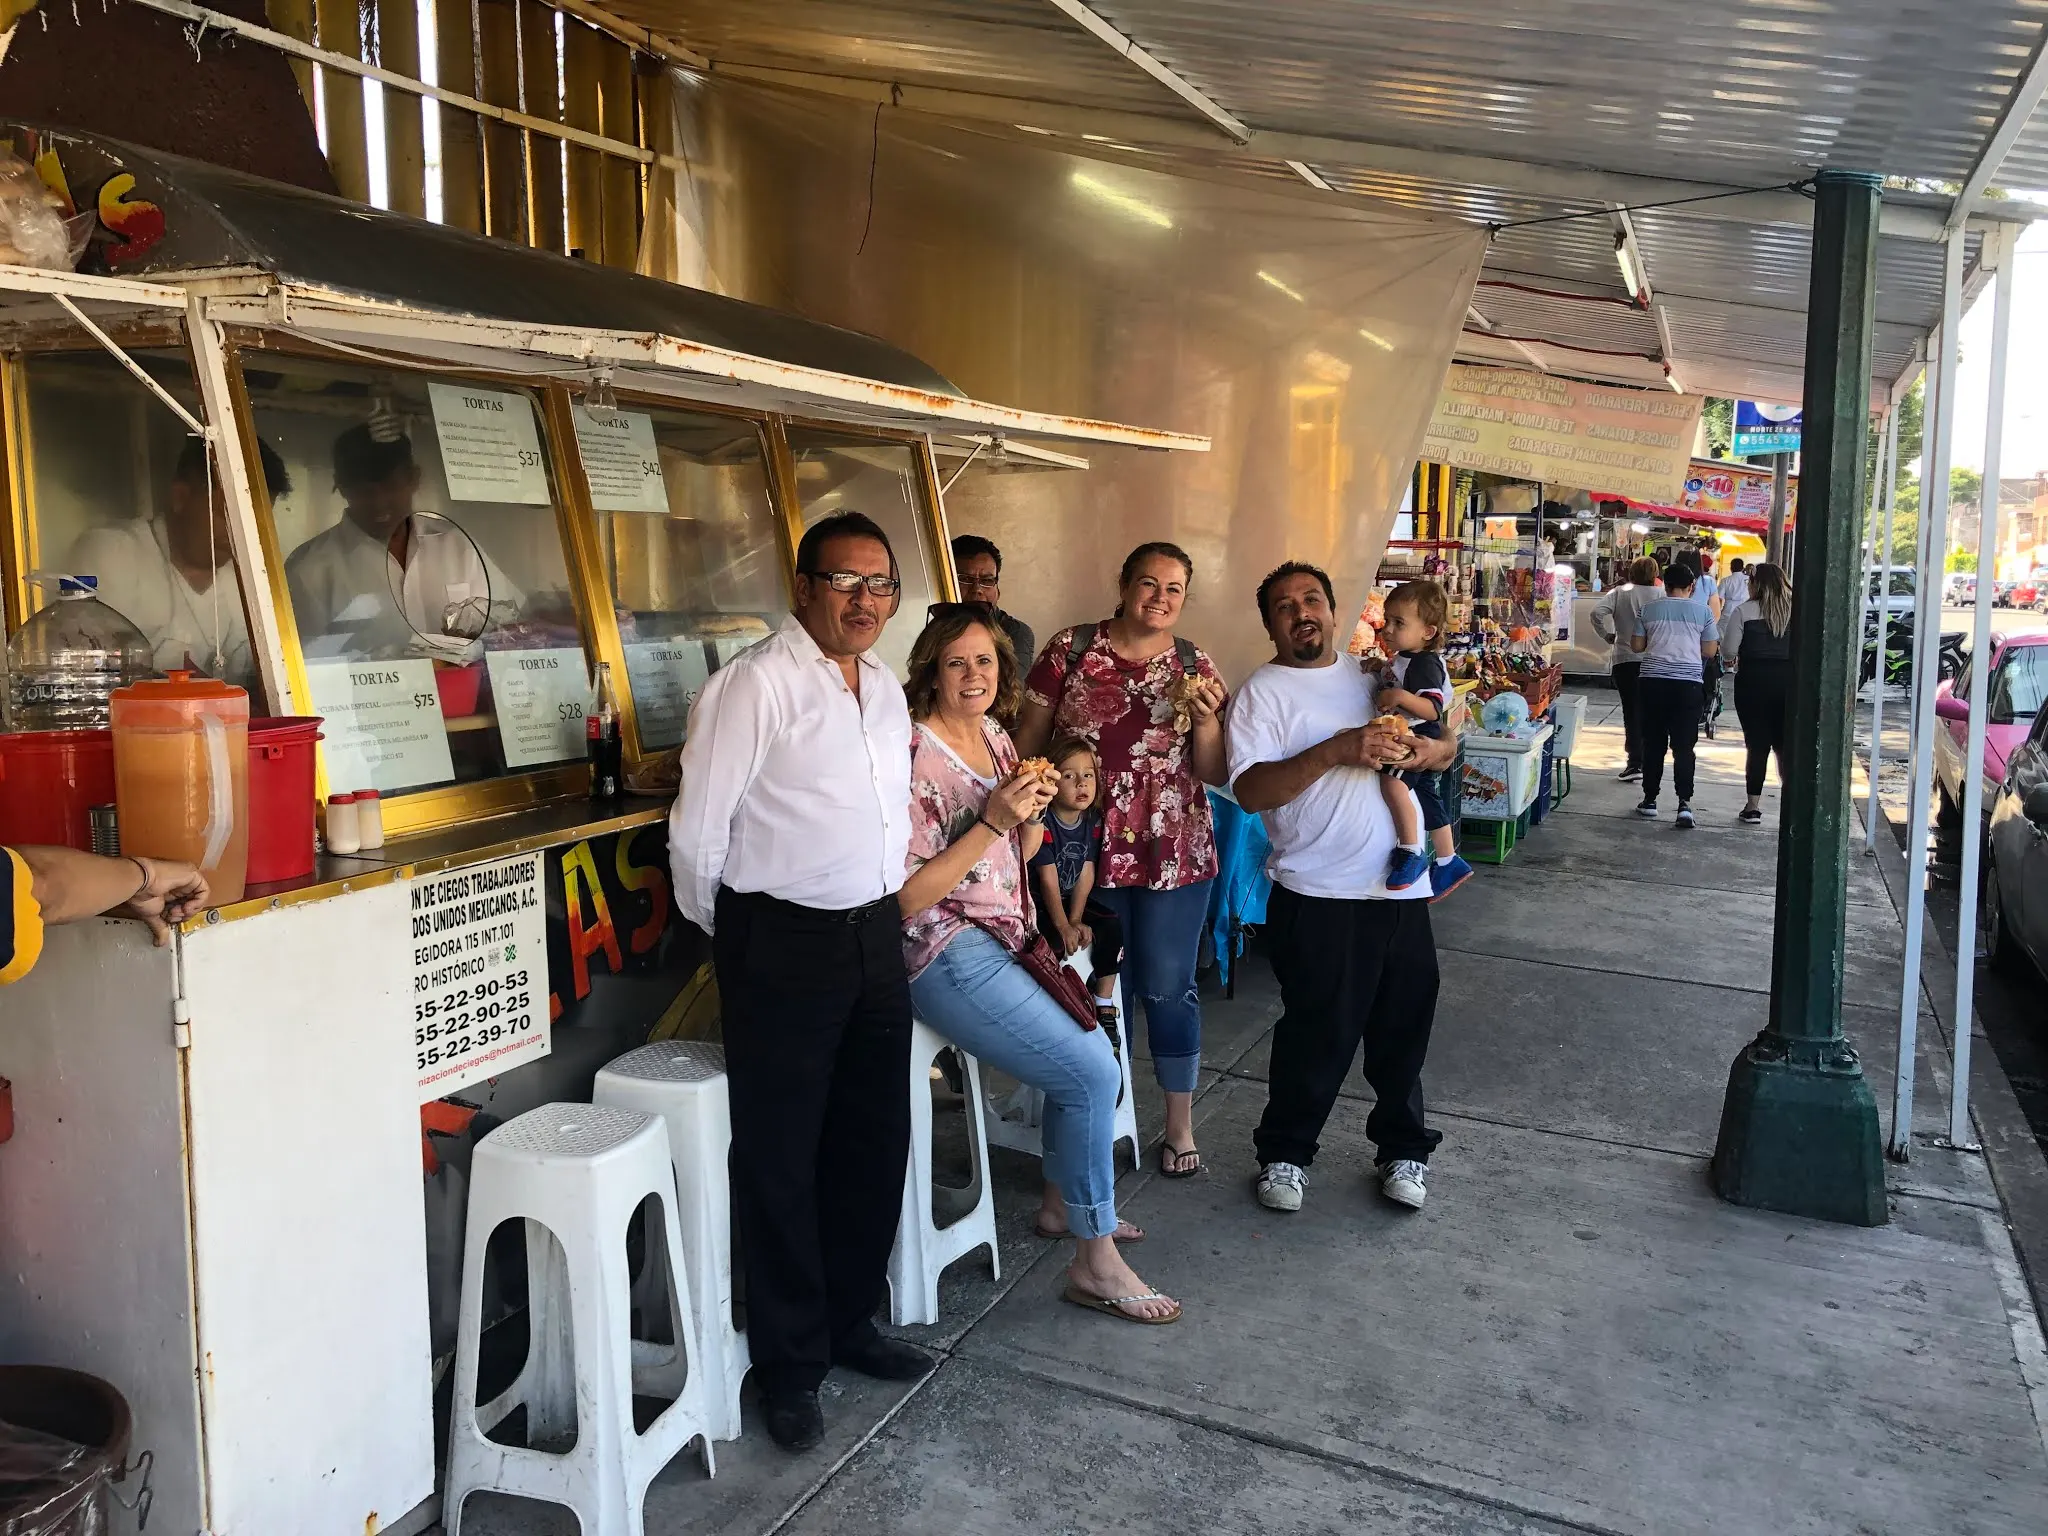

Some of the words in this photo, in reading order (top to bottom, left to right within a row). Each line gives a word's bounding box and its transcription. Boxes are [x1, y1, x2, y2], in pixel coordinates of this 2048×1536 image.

[462, 396, 504, 412] TORTAS
[518, 448, 539, 468] $37
[642, 460, 662, 476] $42
[519, 658, 558, 670] TORTAS
[650, 650, 682, 662] TORTAS
[350, 671, 400, 686] TORTAS
[350, 702, 381, 710] ESPECIAL
[414, 693, 434, 709] $75
[558, 702, 583, 722] $28
[424, 883, 436, 907] DE
[438, 875, 470, 905] CIEGOS
[471, 860, 536, 896] TRABAJADORES
[412, 912, 430, 939] DOS
[433, 904, 466, 933] UNIDOS
[469, 890, 520, 924] MEXICANOS,
[522, 886, 538, 909] A.C.
[415, 936, 462, 966] EGIDORA
[465, 932, 479, 950] 115
[482, 922, 514, 947] INT.101
[432, 956, 485, 989] HISTÓRICO
[418, 1032, 542, 1087] nizaciondeciegos@hotmail.com
